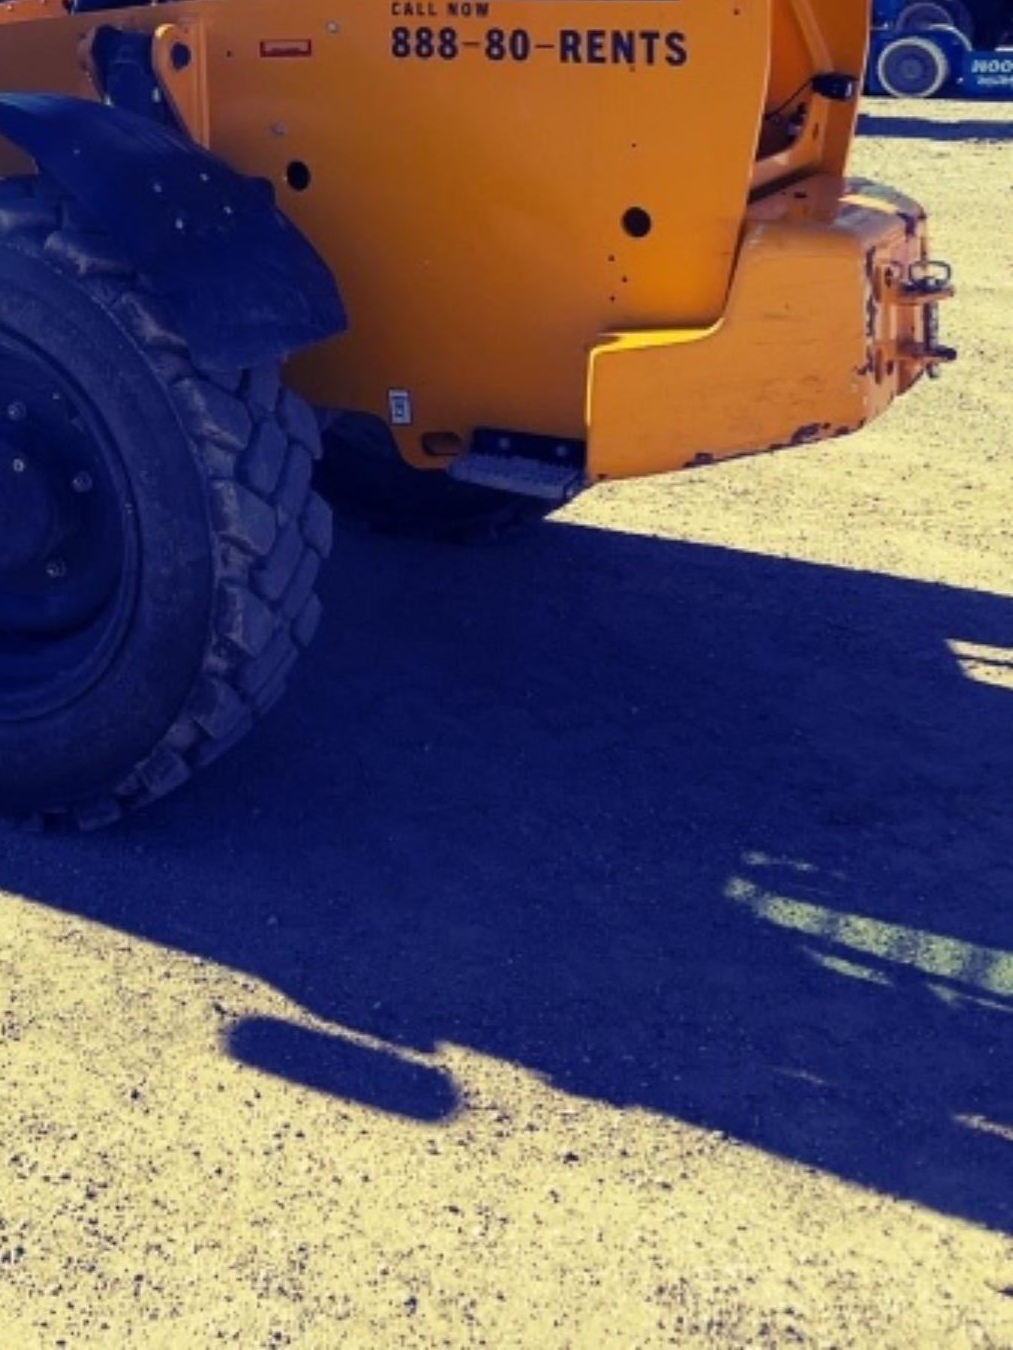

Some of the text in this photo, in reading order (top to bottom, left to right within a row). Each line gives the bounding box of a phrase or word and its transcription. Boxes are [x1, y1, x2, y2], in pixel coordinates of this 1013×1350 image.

[391, 2, 489, 17] CALL NOW
[391, 26, 687, 67] 888-80-RENTS
